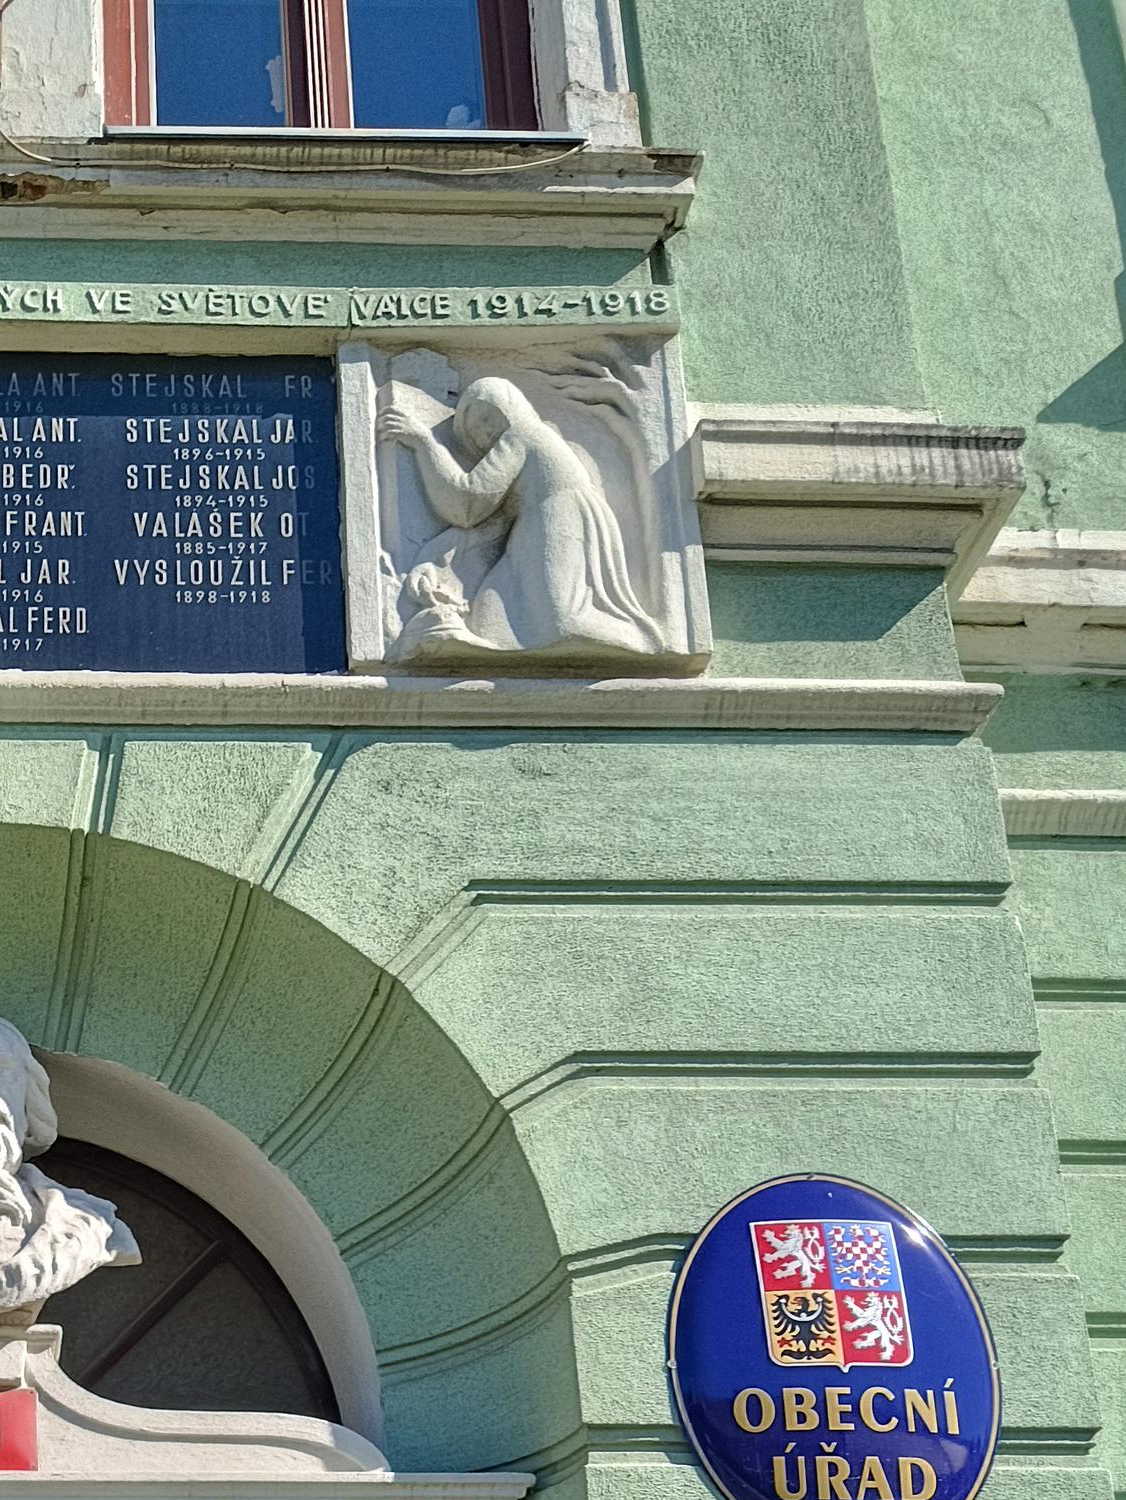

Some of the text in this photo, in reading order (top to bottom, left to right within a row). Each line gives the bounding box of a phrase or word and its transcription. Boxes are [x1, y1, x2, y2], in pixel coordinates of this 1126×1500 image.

[85, 288, 133, 314] VE
[468, 290, 671, 318] 1914-1918
[111, 373, 246, 398] STEJSKAL
[4, 401, 44, 413] 1916
[32, 417, 82, 442] ANT.
[126, 418, 262, 444] STEJSKAL
[4, 446, 44, 459] 1916
[174, 448, 266, 461] 1896-1915
[126, 464, 264, 490] STEJSKAL
[4, 493, 44, 506] 1916
[175, 495, 269, 508] 1894-1915
[5, 510, 88, 537] FRANT.
[133, 507, 264, 537] VALÁŠEK
[3, 540, 43, 554] 1915
[175, 541, 268, 555] 1885-1917
[20, 558, 76, 585] JAR.
[114, 556, 272, 586] VYSLOUŽIL
[2, 589, 44, 602] 1916
[175, 590, 271, 604] 1898-1918
[27, 606, 90, 634] FERD.
[2, 638, 44, 651] 1917
[732, 1377, 960, 1436] OBECNÍ
